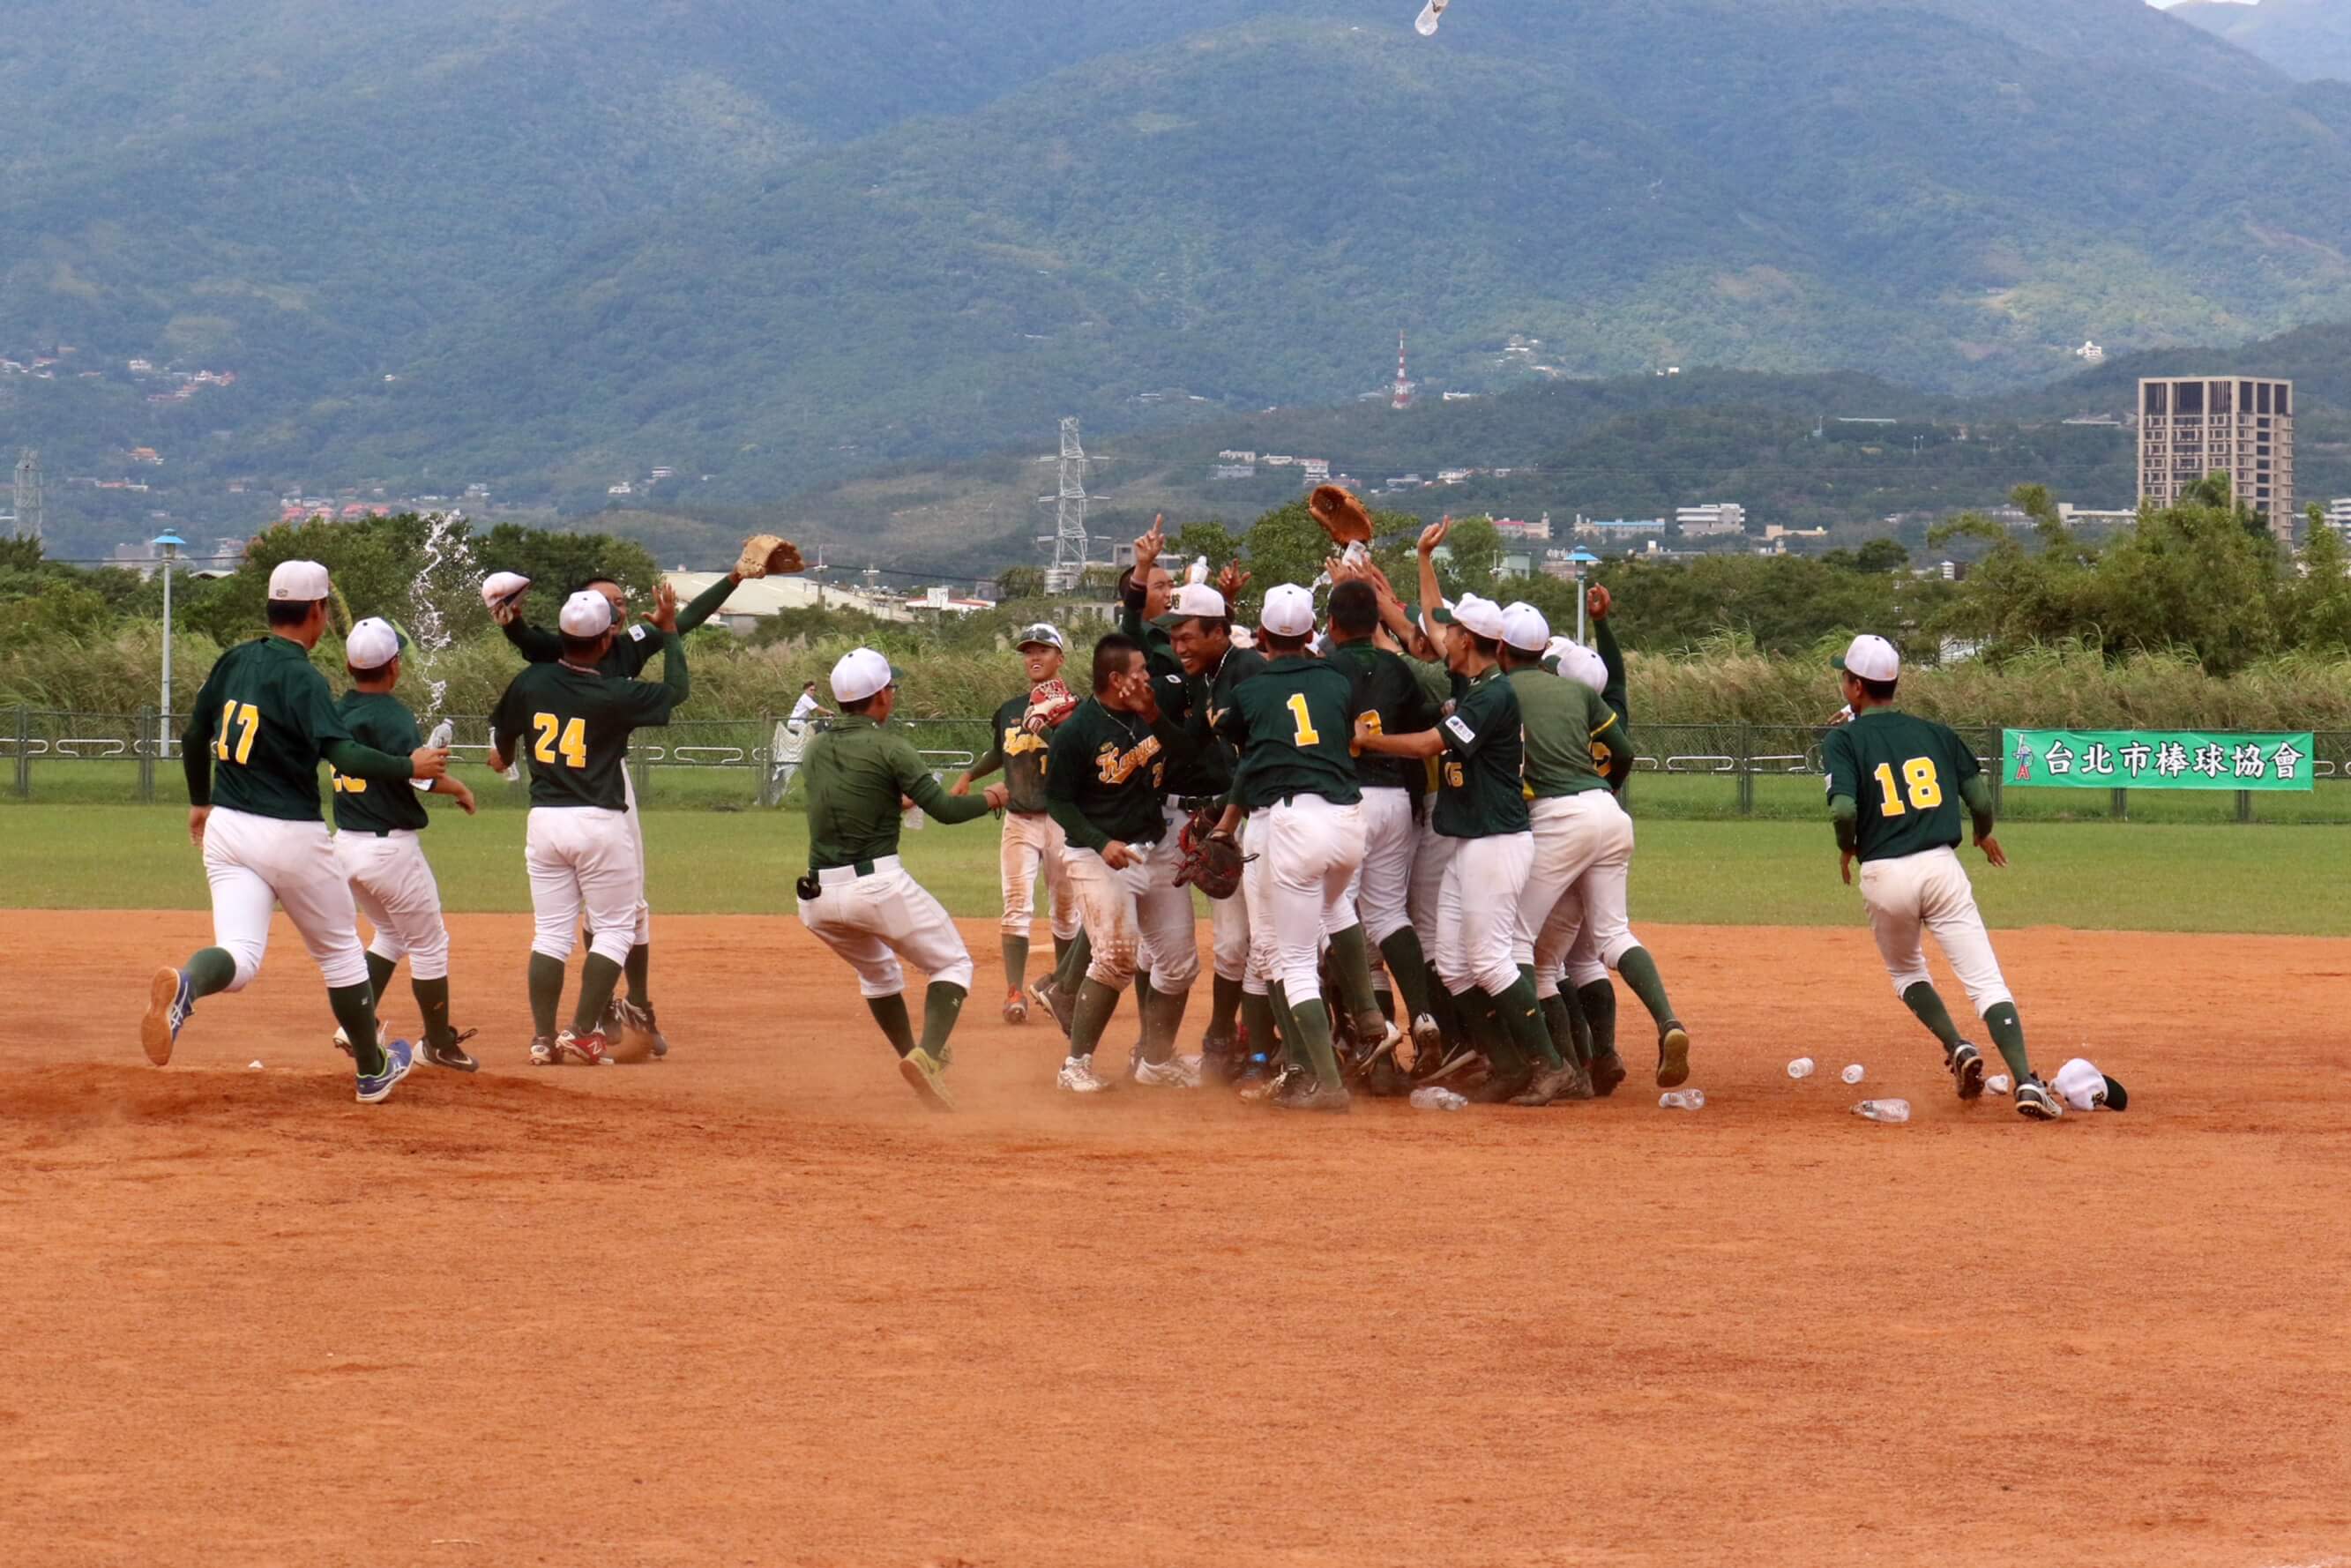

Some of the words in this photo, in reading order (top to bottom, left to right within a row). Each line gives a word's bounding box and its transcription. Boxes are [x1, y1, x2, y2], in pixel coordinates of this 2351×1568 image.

[218, 699, 259, 765] 17
[534, 712, 586, 768] 24
[1287, 693, 1319, 746] 1
[1874, 756, 1943, 817] 18
[2043, 739, 2305, 780] 台北市棒球協會
